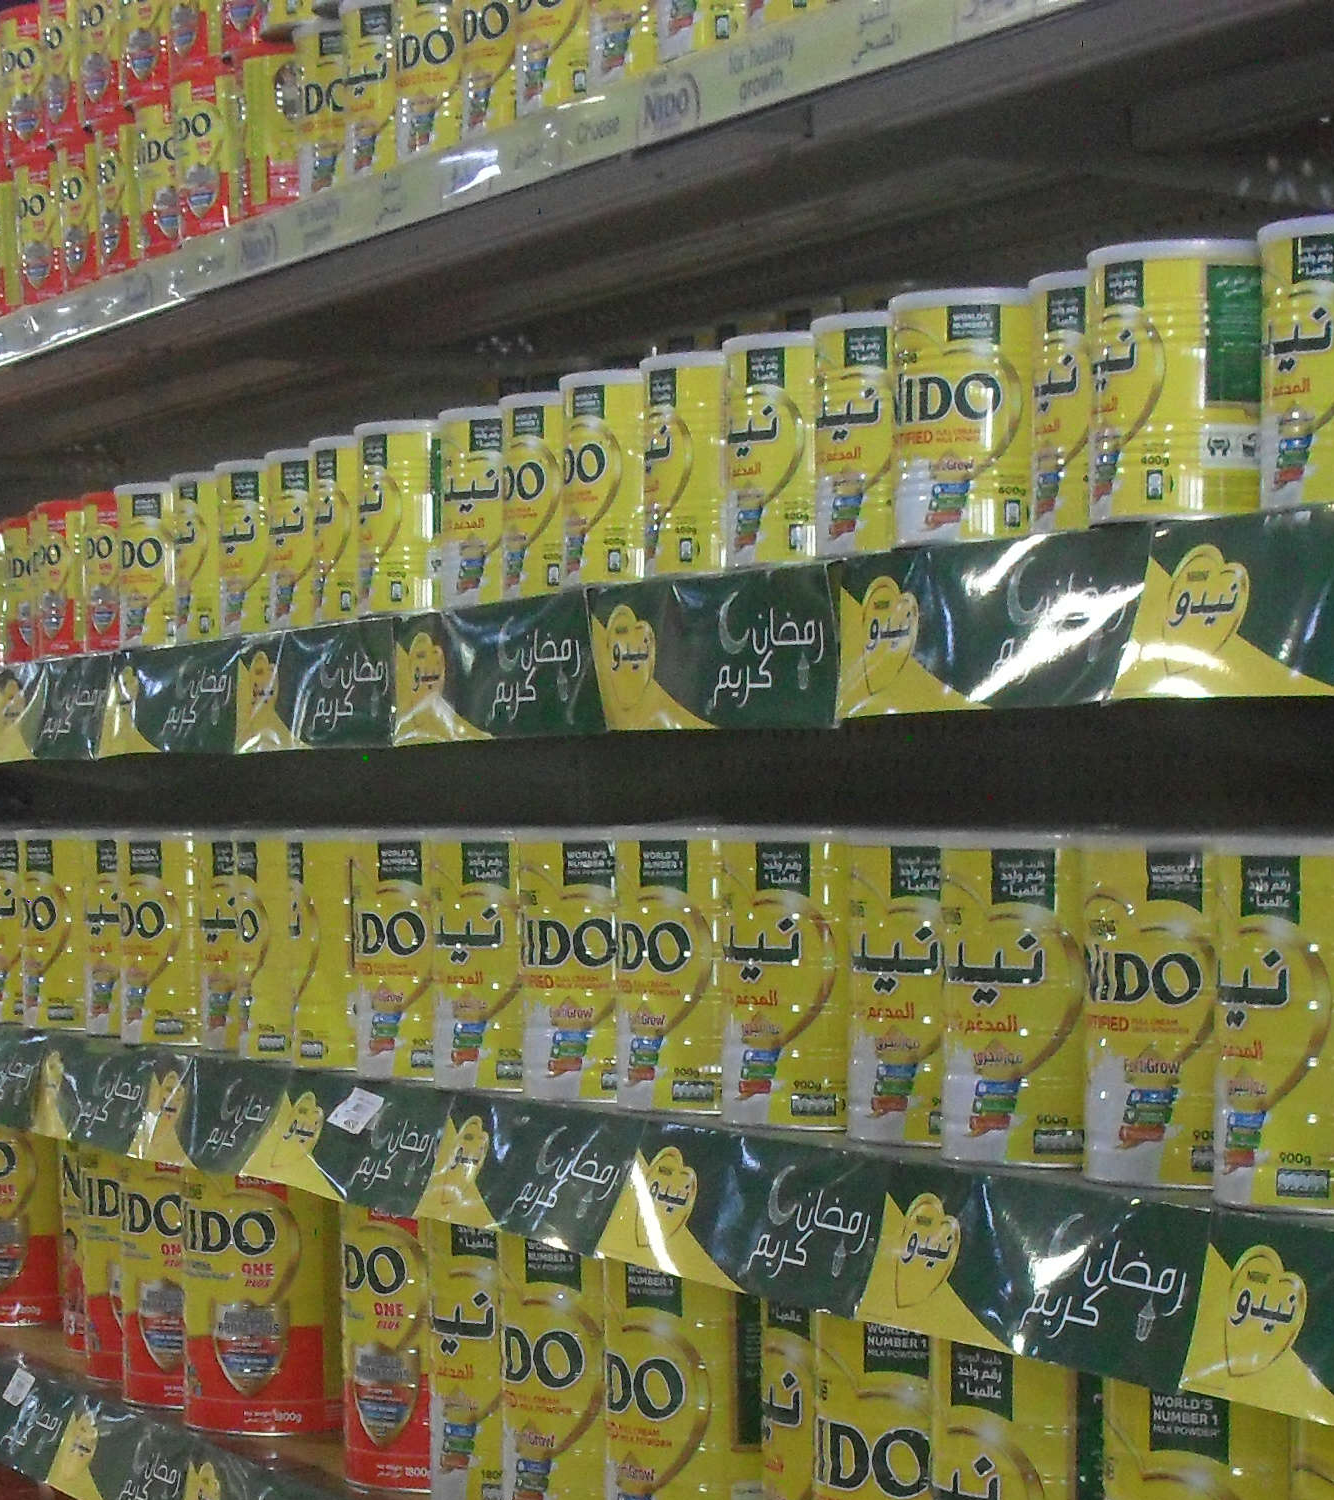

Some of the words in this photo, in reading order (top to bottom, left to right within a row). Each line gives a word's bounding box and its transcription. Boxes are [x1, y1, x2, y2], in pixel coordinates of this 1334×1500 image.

[749, 608, 824, 668] رمضان
[714, 650, 773, 703] كريم
[1036, 1115, 1068, 1126] 900g
[1279, 1151, 1312, 1166] 900g
[796, 1189, 872, 1254] رمضان
[747, 1230, 811, 1279] كريم
[901, 1229, 955, 1268] نيدو
[1083, 1239, 1188, 1317] رمضان
[1019, 1285, 1108, 1339] كريم
[1228, 1287, 1297, 1335] نيدو
[1153, 1395, 1214, 1409] WORLD'S
[1153, 1410, 1207, 1424] NUMBER
